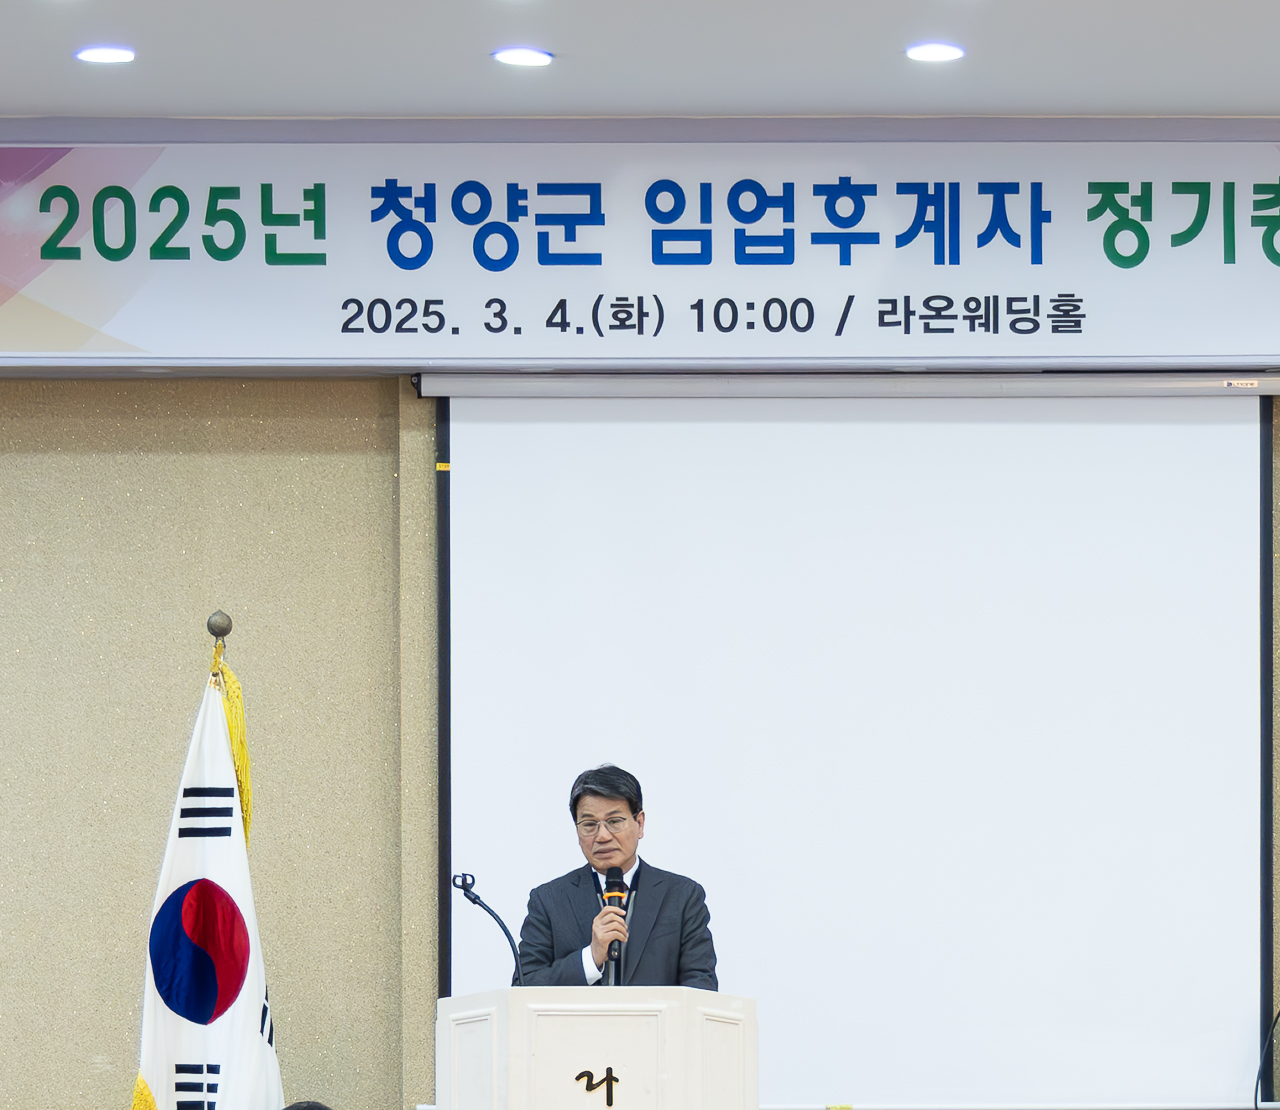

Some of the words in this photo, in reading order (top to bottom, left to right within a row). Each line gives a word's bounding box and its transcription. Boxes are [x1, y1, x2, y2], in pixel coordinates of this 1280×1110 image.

[37, 181, 327, 267] 2025년
[369, 177, 607, 273] 청양군
[643, 176, 1052, 267] 임업후계자
[341, 298, 460, 335] 2025.
[483, 297, 522, 335] 3.
[545, 294, 665, 337] 4.(화)
[690, 297, 816, 333] 10:00
[835, 294, 855, 337] /
[878, 293, 1088, 335] 라온웨딩홀
